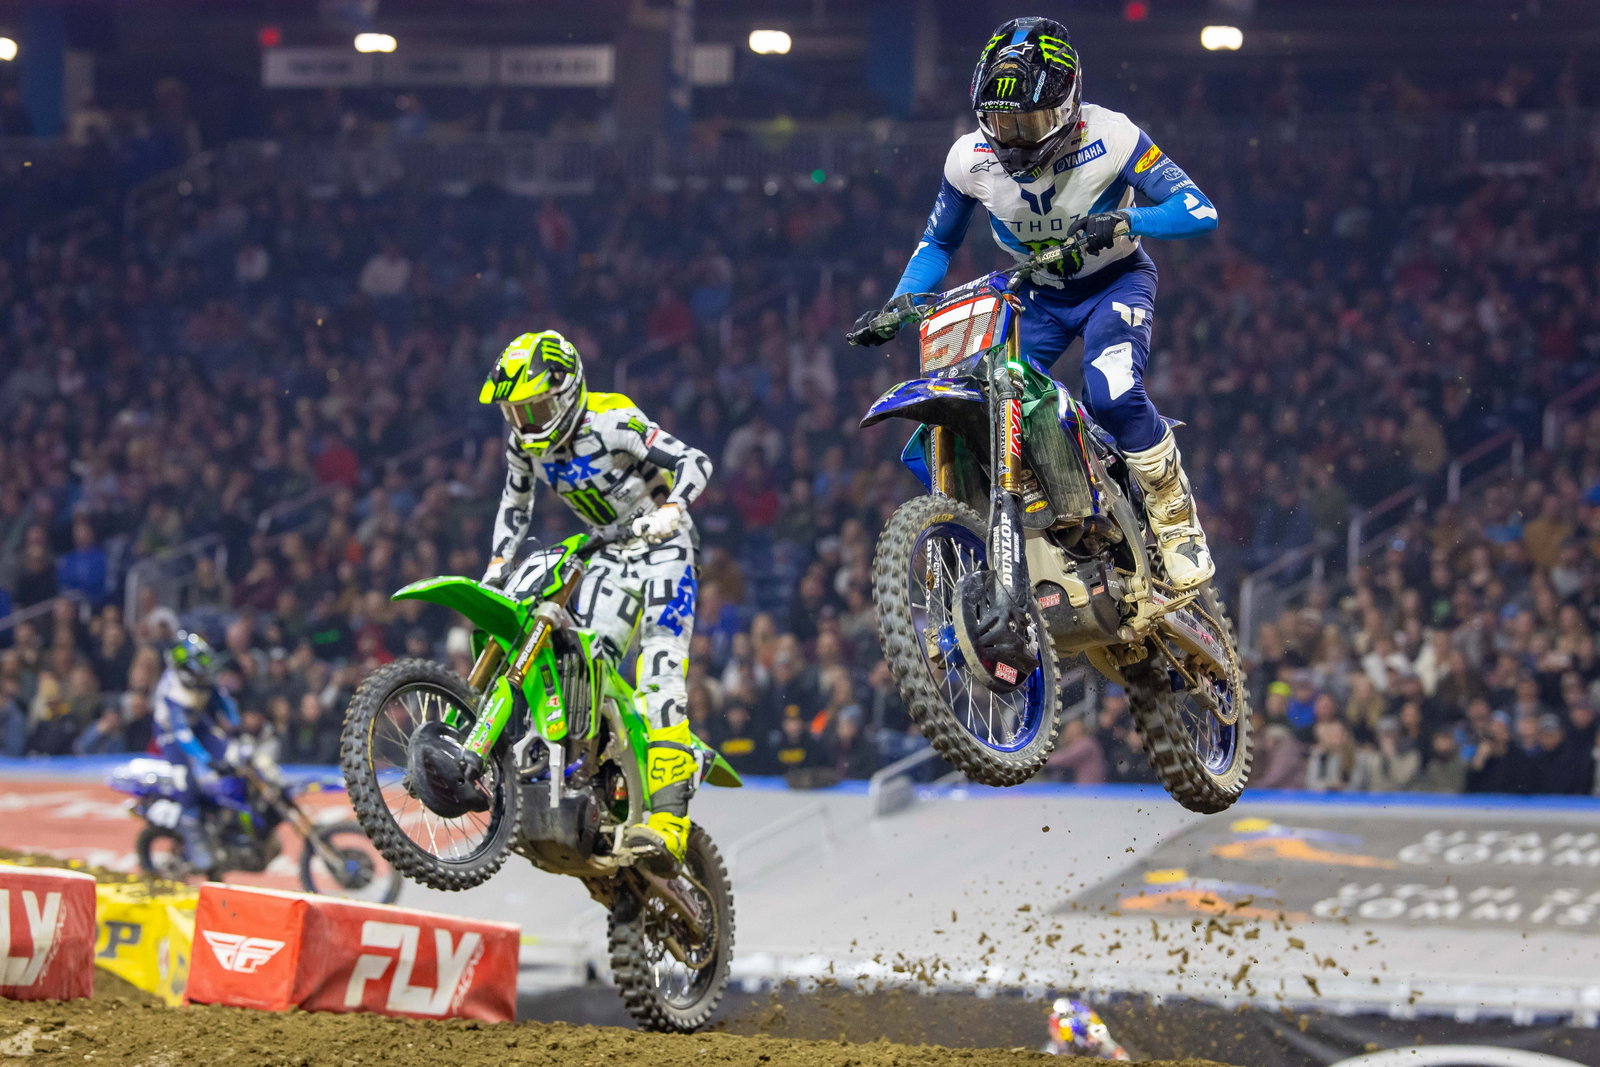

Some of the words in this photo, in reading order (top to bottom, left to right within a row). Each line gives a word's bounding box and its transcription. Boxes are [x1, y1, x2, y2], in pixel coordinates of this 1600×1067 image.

[980, 100, 1021, 108] MONSTER
[1065, 143, 1104, 168] YAMAHA
[993, 526, 1001, 553] CYCRA
[1001, 512, 1013, 588] DUNLOP
[516, 649, 530, 670] PRO
[526, 620, 545, 654] CIRCUIT
[343, 920, 481, 1016] FLY
